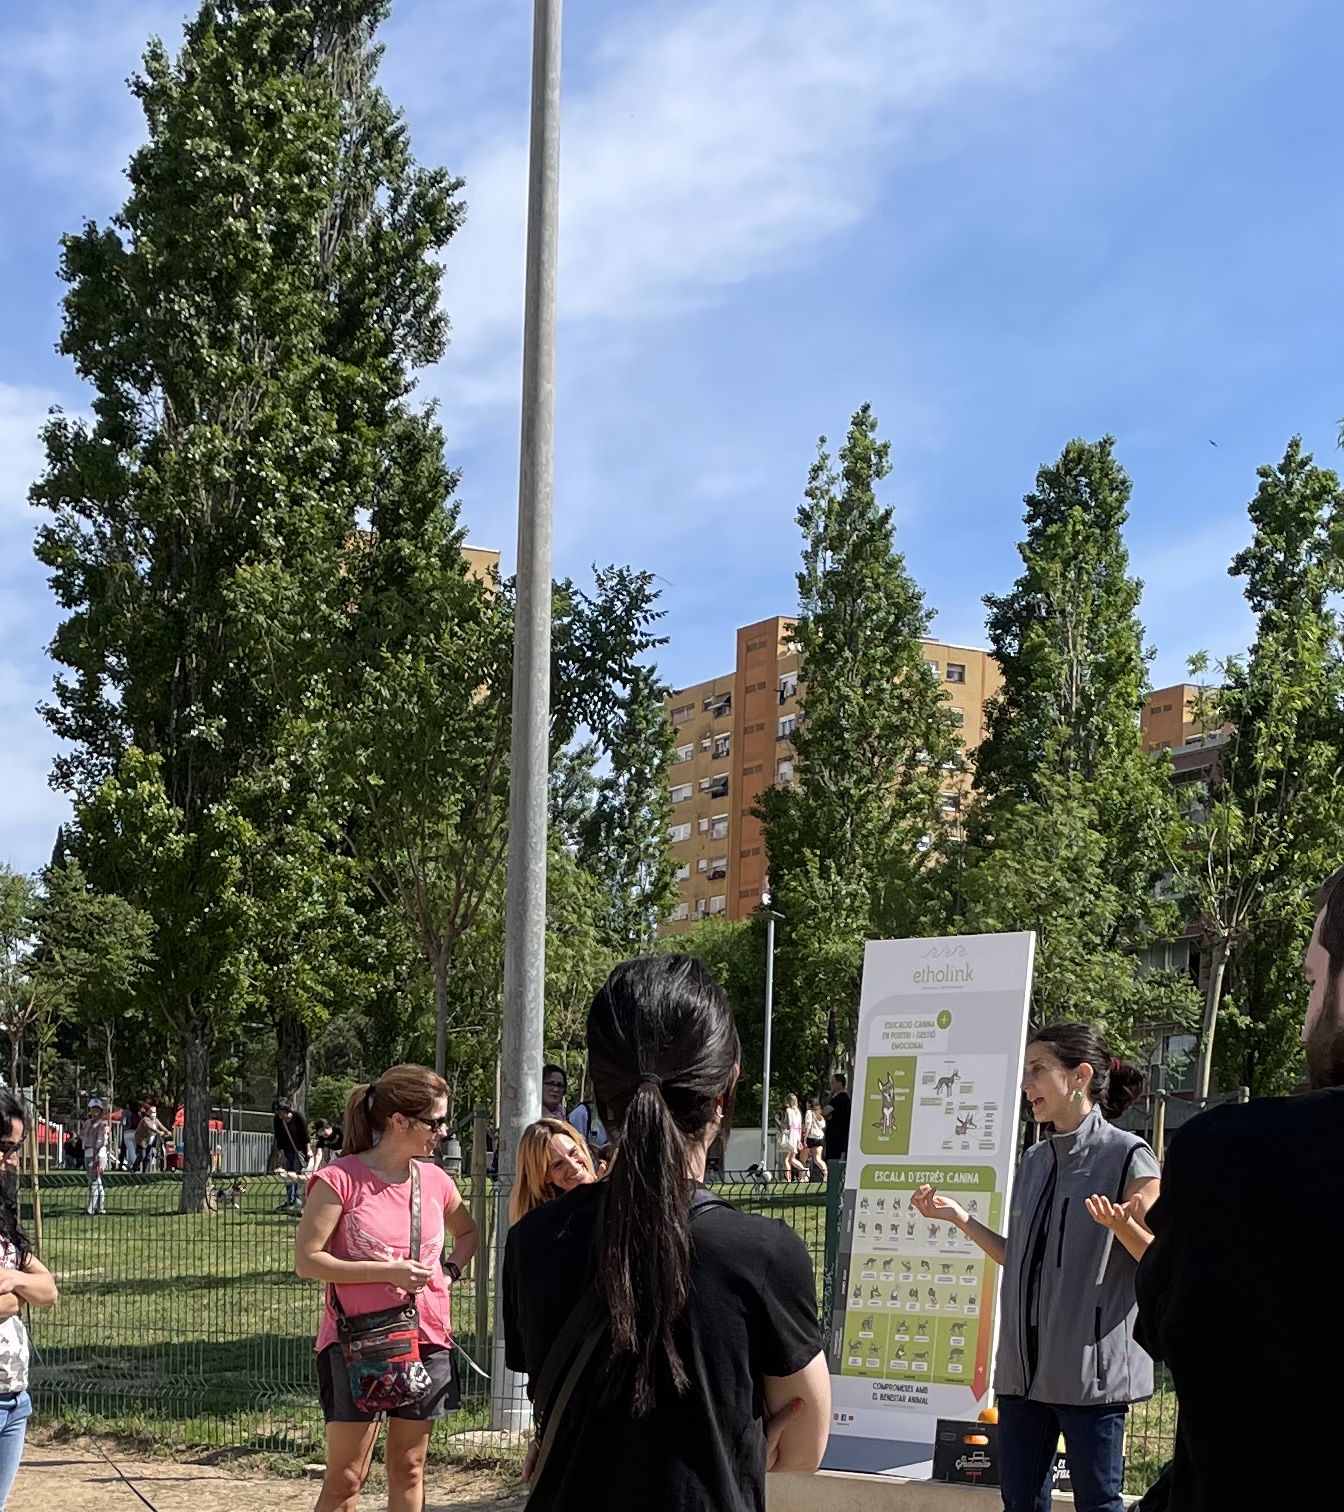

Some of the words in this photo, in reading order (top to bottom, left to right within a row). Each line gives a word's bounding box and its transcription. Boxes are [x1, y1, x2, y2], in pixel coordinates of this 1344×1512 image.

[912, 962, 974, 984] etholink
[874, 1170, 905, 1182] ESCALA
[946, 1172, 979, 1184] CANINA
[872, 1382, 914, 1393] COMPROMESES
[915, 1385, 929, 1394] AMB
[879, 1393, 906, 1403] BENESTAR
[908, 1396, 929, 1405] ANIMAL
